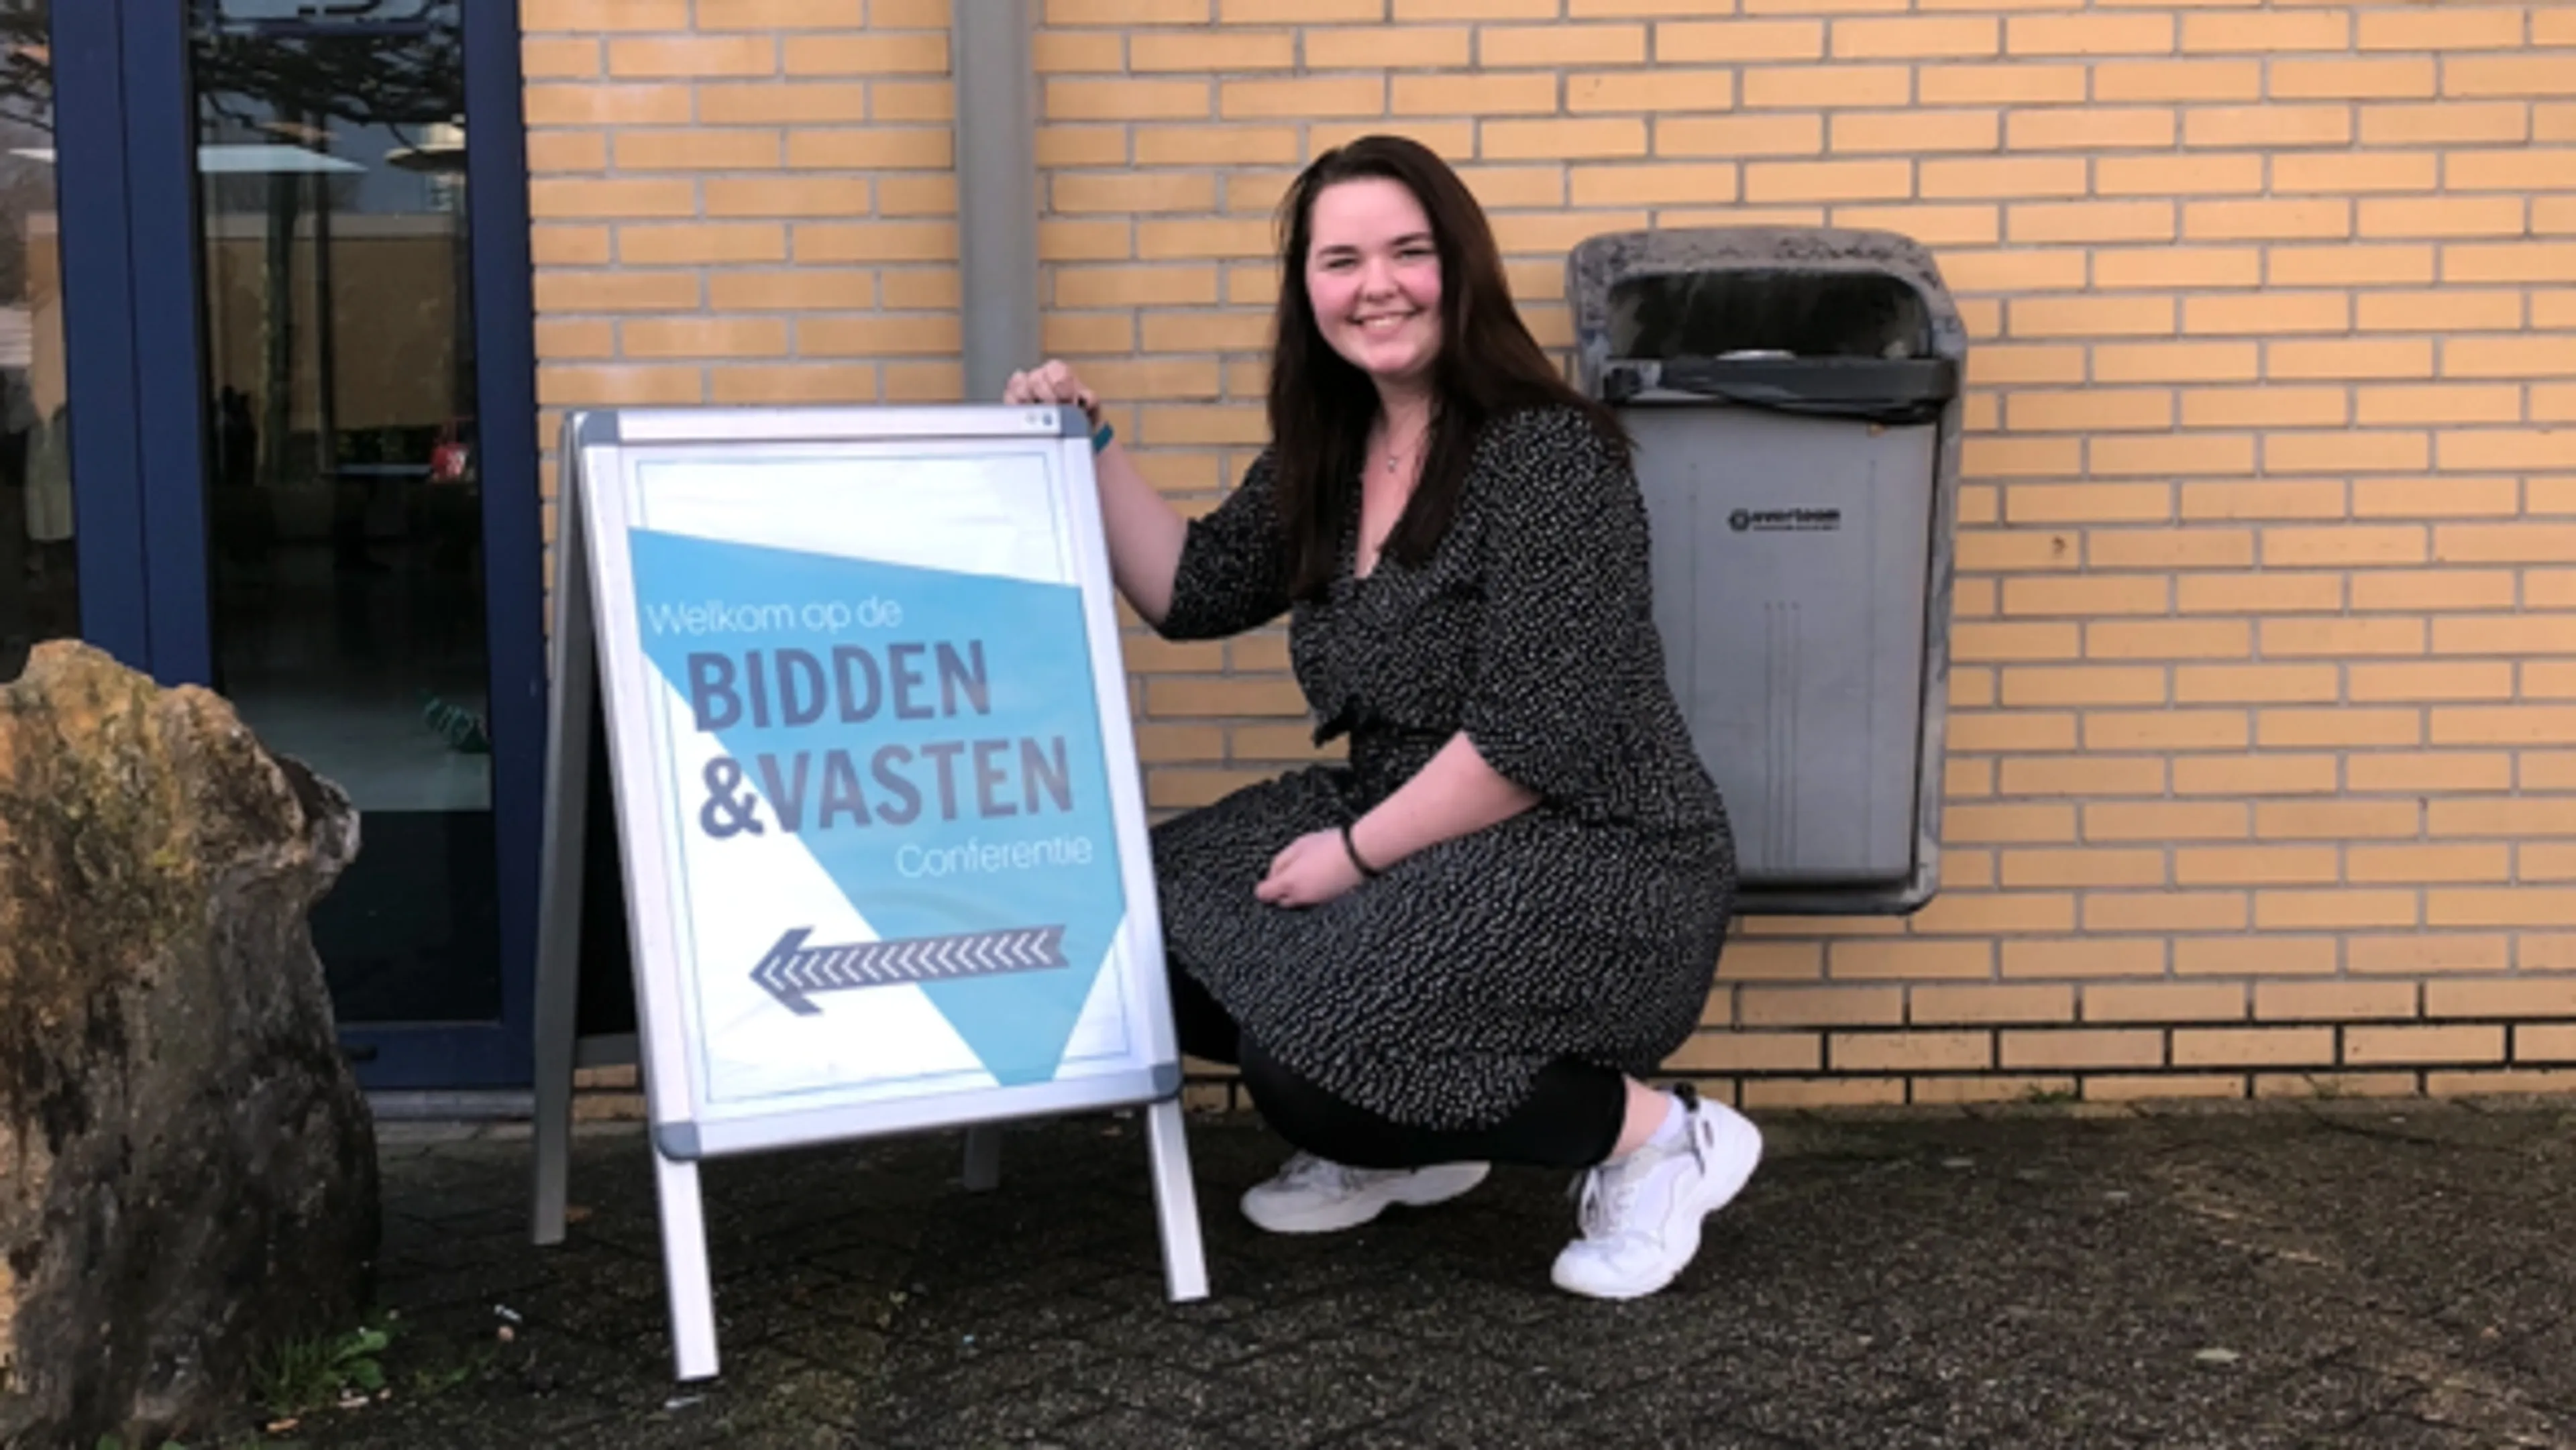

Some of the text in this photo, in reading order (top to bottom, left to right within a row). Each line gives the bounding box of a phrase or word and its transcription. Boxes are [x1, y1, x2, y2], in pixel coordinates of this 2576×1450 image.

[647, 596, 903, 635] Welkom op de
[686, 639, 991, 732] BIDDEN
[896, 834, 1094, 877] Conferentie
